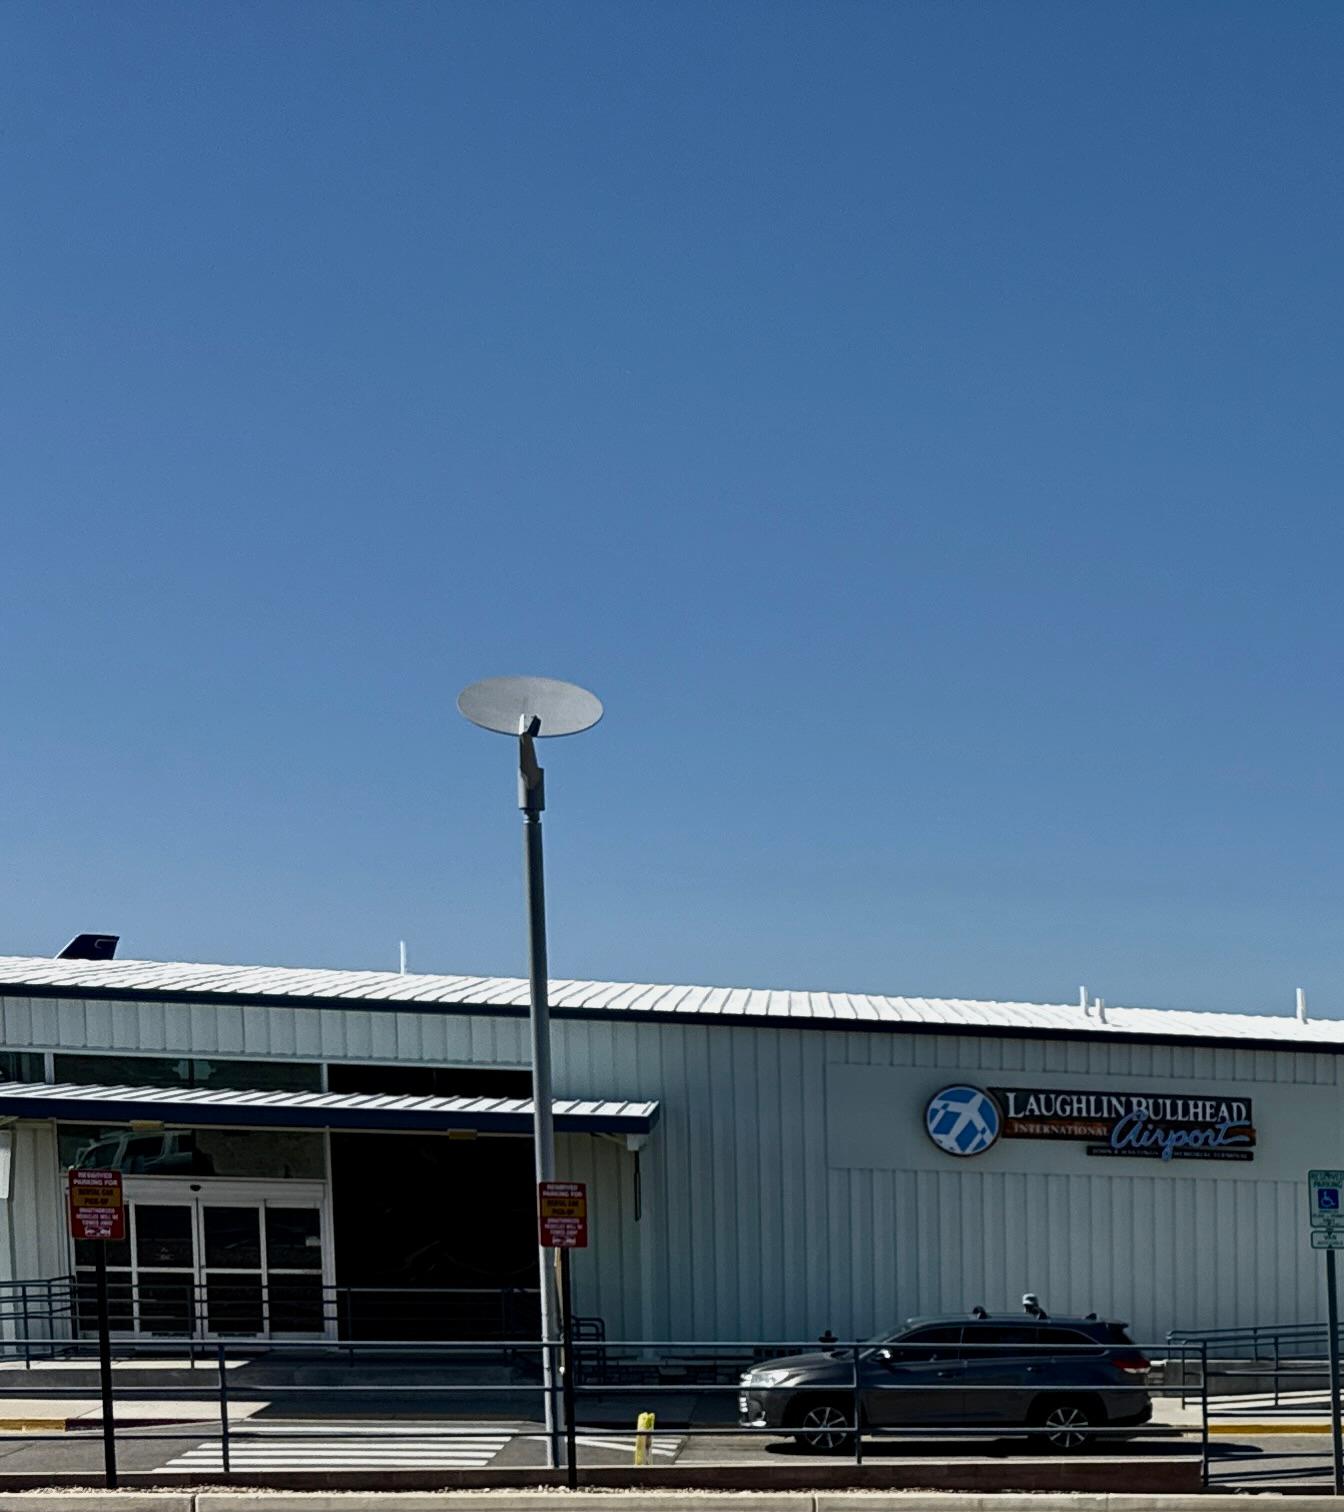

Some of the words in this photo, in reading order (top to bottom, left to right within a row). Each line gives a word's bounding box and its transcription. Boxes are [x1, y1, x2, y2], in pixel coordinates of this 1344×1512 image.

[1006, 1091, 1126, 1119] LAUGHLIN
[1130, 1097, 1247, 1123] BULLHEAD
[1013, 1123, 1110, 1137] INTERNATIONAL
[1111, 1110, 1250, 1161] Airport
